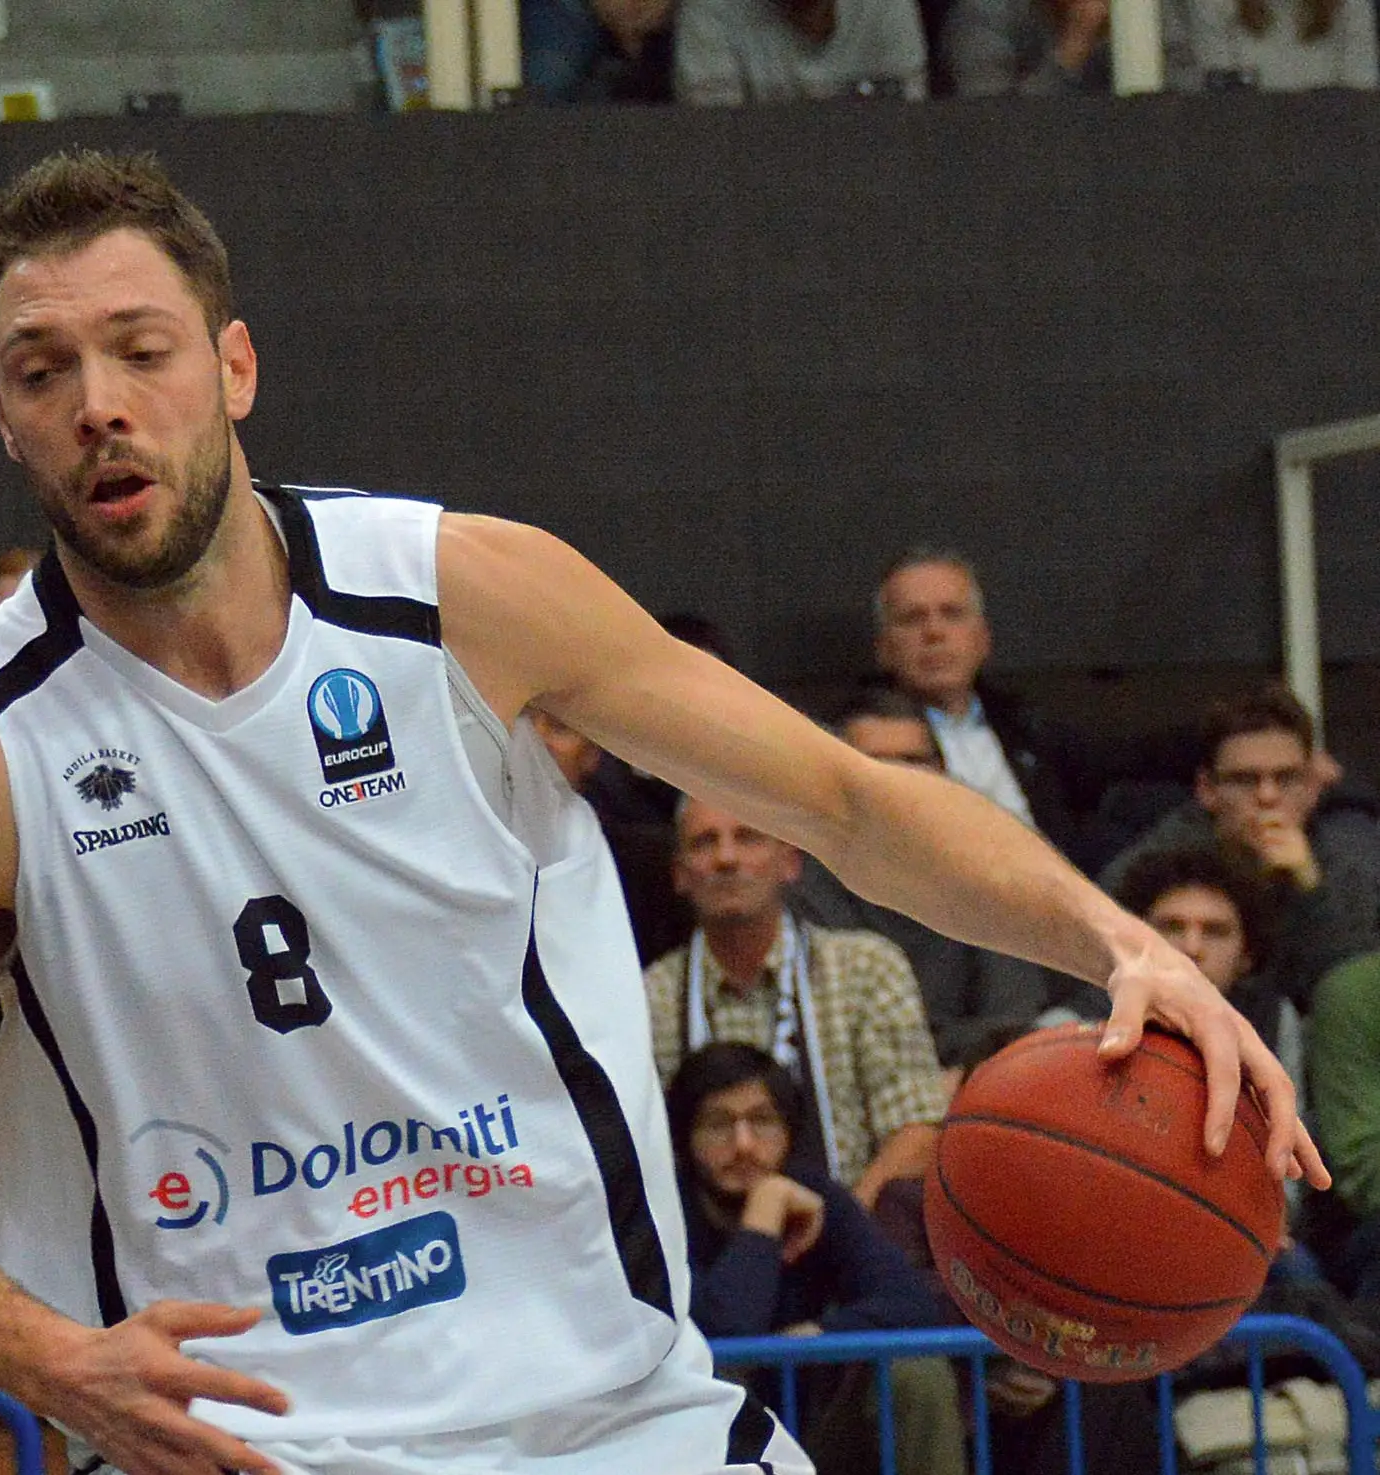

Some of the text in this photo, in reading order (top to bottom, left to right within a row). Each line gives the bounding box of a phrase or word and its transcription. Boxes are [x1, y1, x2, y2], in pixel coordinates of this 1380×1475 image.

[62, 748, 141, 781] AQUILA BASKET
[324, 741, 388, 767] EUROCUP
[73, 811, 170, 855] SPALDING
[233, 894, 333, 1035] 8
[251, 1094, 519, 1196] Dolomiti
[348, 1162, 535, 1219] energia
[279, 1239, 452, 1315] TRENTINO
